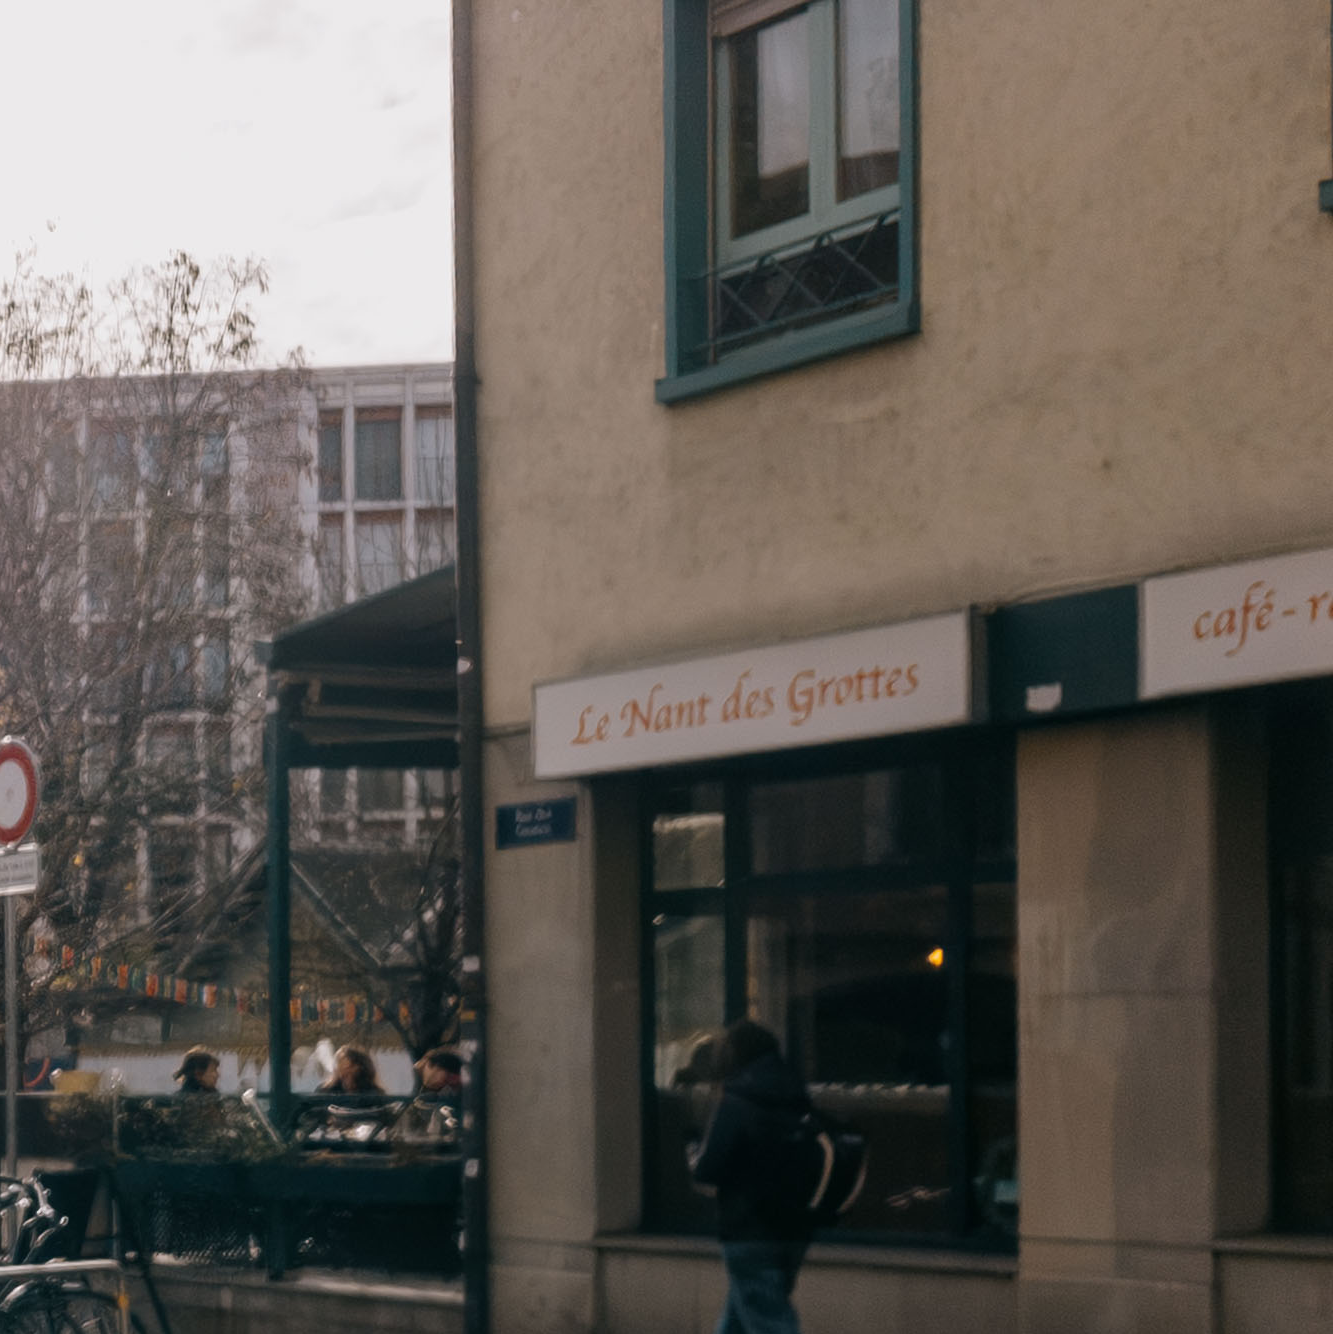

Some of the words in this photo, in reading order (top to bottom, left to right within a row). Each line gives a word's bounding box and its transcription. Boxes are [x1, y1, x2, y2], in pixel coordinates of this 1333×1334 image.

[570, 704, 609, 744] Le
[620, 683, 712, 737] Nant
[721, 667, 775, 723] des
[787, 663, 918, 726] Grottes
